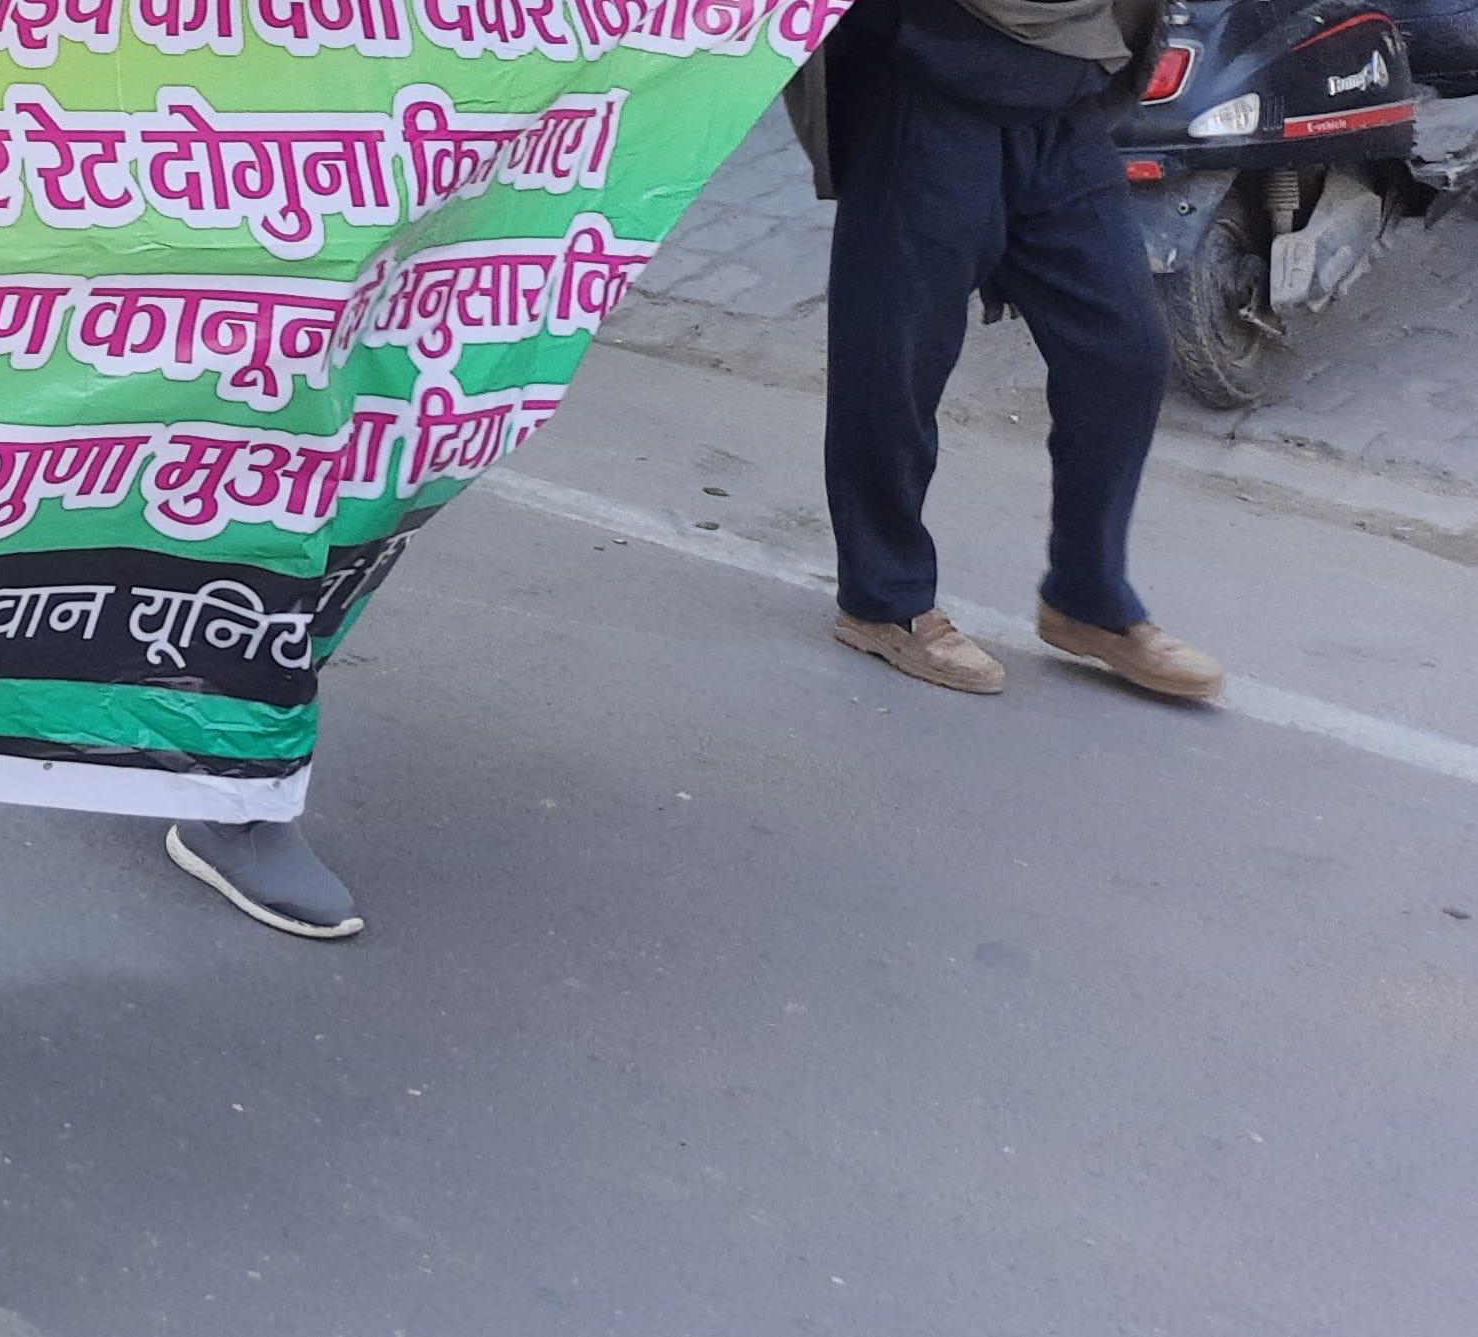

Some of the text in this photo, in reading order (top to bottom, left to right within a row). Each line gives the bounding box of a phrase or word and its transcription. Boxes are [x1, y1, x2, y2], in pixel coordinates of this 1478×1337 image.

[15, 102, 134, 211] रेट
[141, 104, 390, 243] दोगुना
[79, 285, 347, 397] कानून
